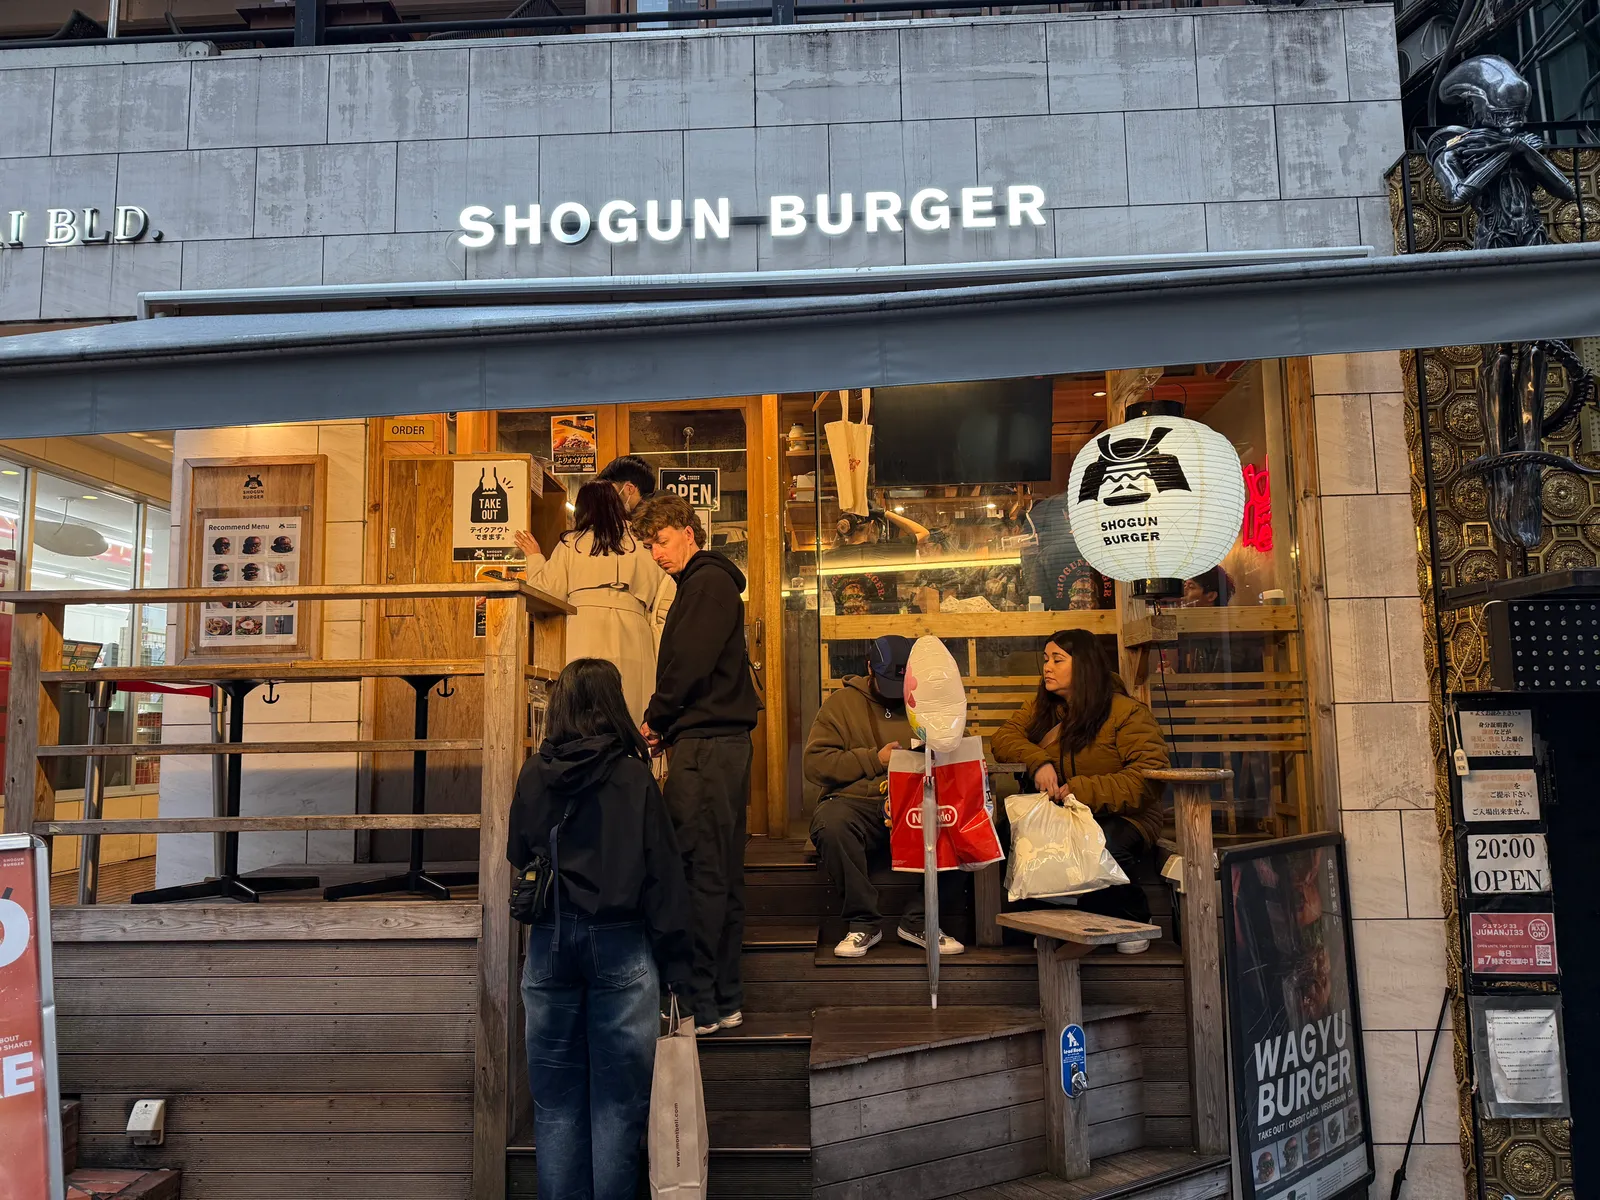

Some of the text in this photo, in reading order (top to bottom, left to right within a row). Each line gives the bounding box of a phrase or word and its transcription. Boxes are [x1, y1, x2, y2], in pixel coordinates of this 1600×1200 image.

[45, 205, 165, 246] BLD.
[458, 184, 1047, 247] SHOGUN BURGER
[391, 425, 425, 435] ORDER
[478, 498, 501, 508] TAKE
[482, 510, 498, 520] OUT
[1101, 516, 1158, 531] SHOGUN
[1103, 532, 1160, 546] BURGER
[1475, 838, 1535, 859] 20:00
[1474, 870, 1542, 891] OPEN
[3, 1040, 32, 1051] SHAKE?
[1254, 1009, 1346, 1081] WAGYU
[1258, 1049, 1351, 1126] BURGER
[1258, 1130, 1272, 1141] TAKE
[1273, 1123, 1285, 1134] OUT
[1288, 1114, 1306, 1128] CREDIT
[1306, 1106, 1319, 1120] CARD
